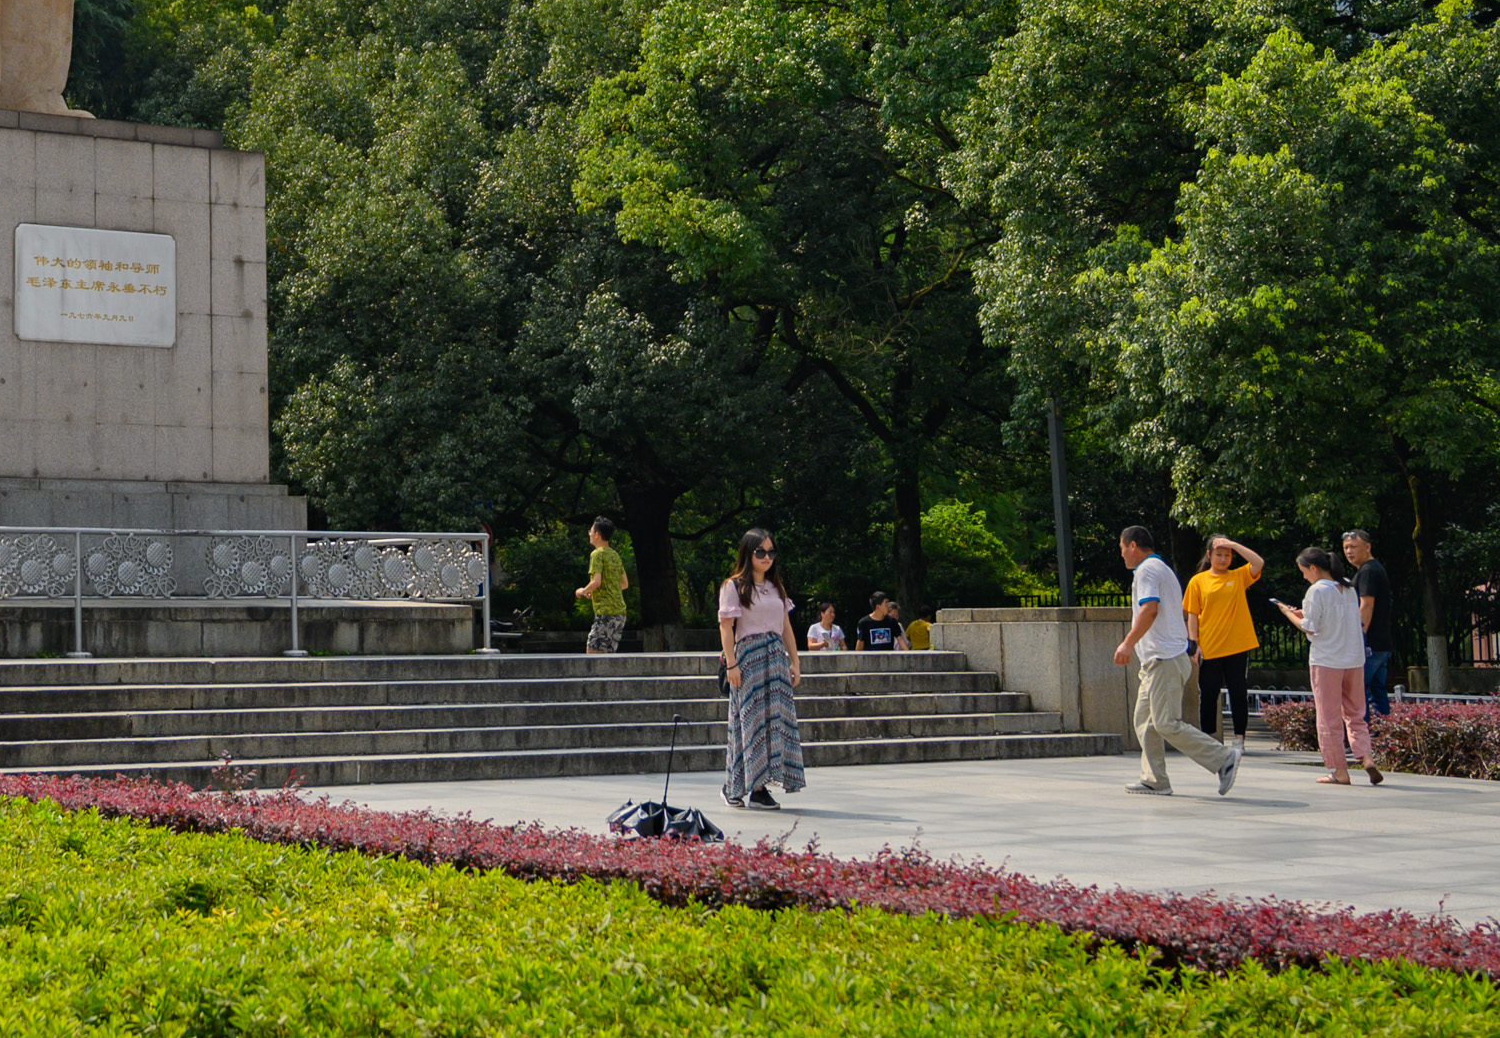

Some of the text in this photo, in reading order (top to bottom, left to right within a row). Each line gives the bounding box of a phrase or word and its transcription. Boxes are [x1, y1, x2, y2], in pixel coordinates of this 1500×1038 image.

[34, 256, 160, 274] 伟大的领袖和导师
[26, 277, 167, 296] 毛泽东主席永垂不朽
[60, 312, 134, 322] 一九七六年九月九日
